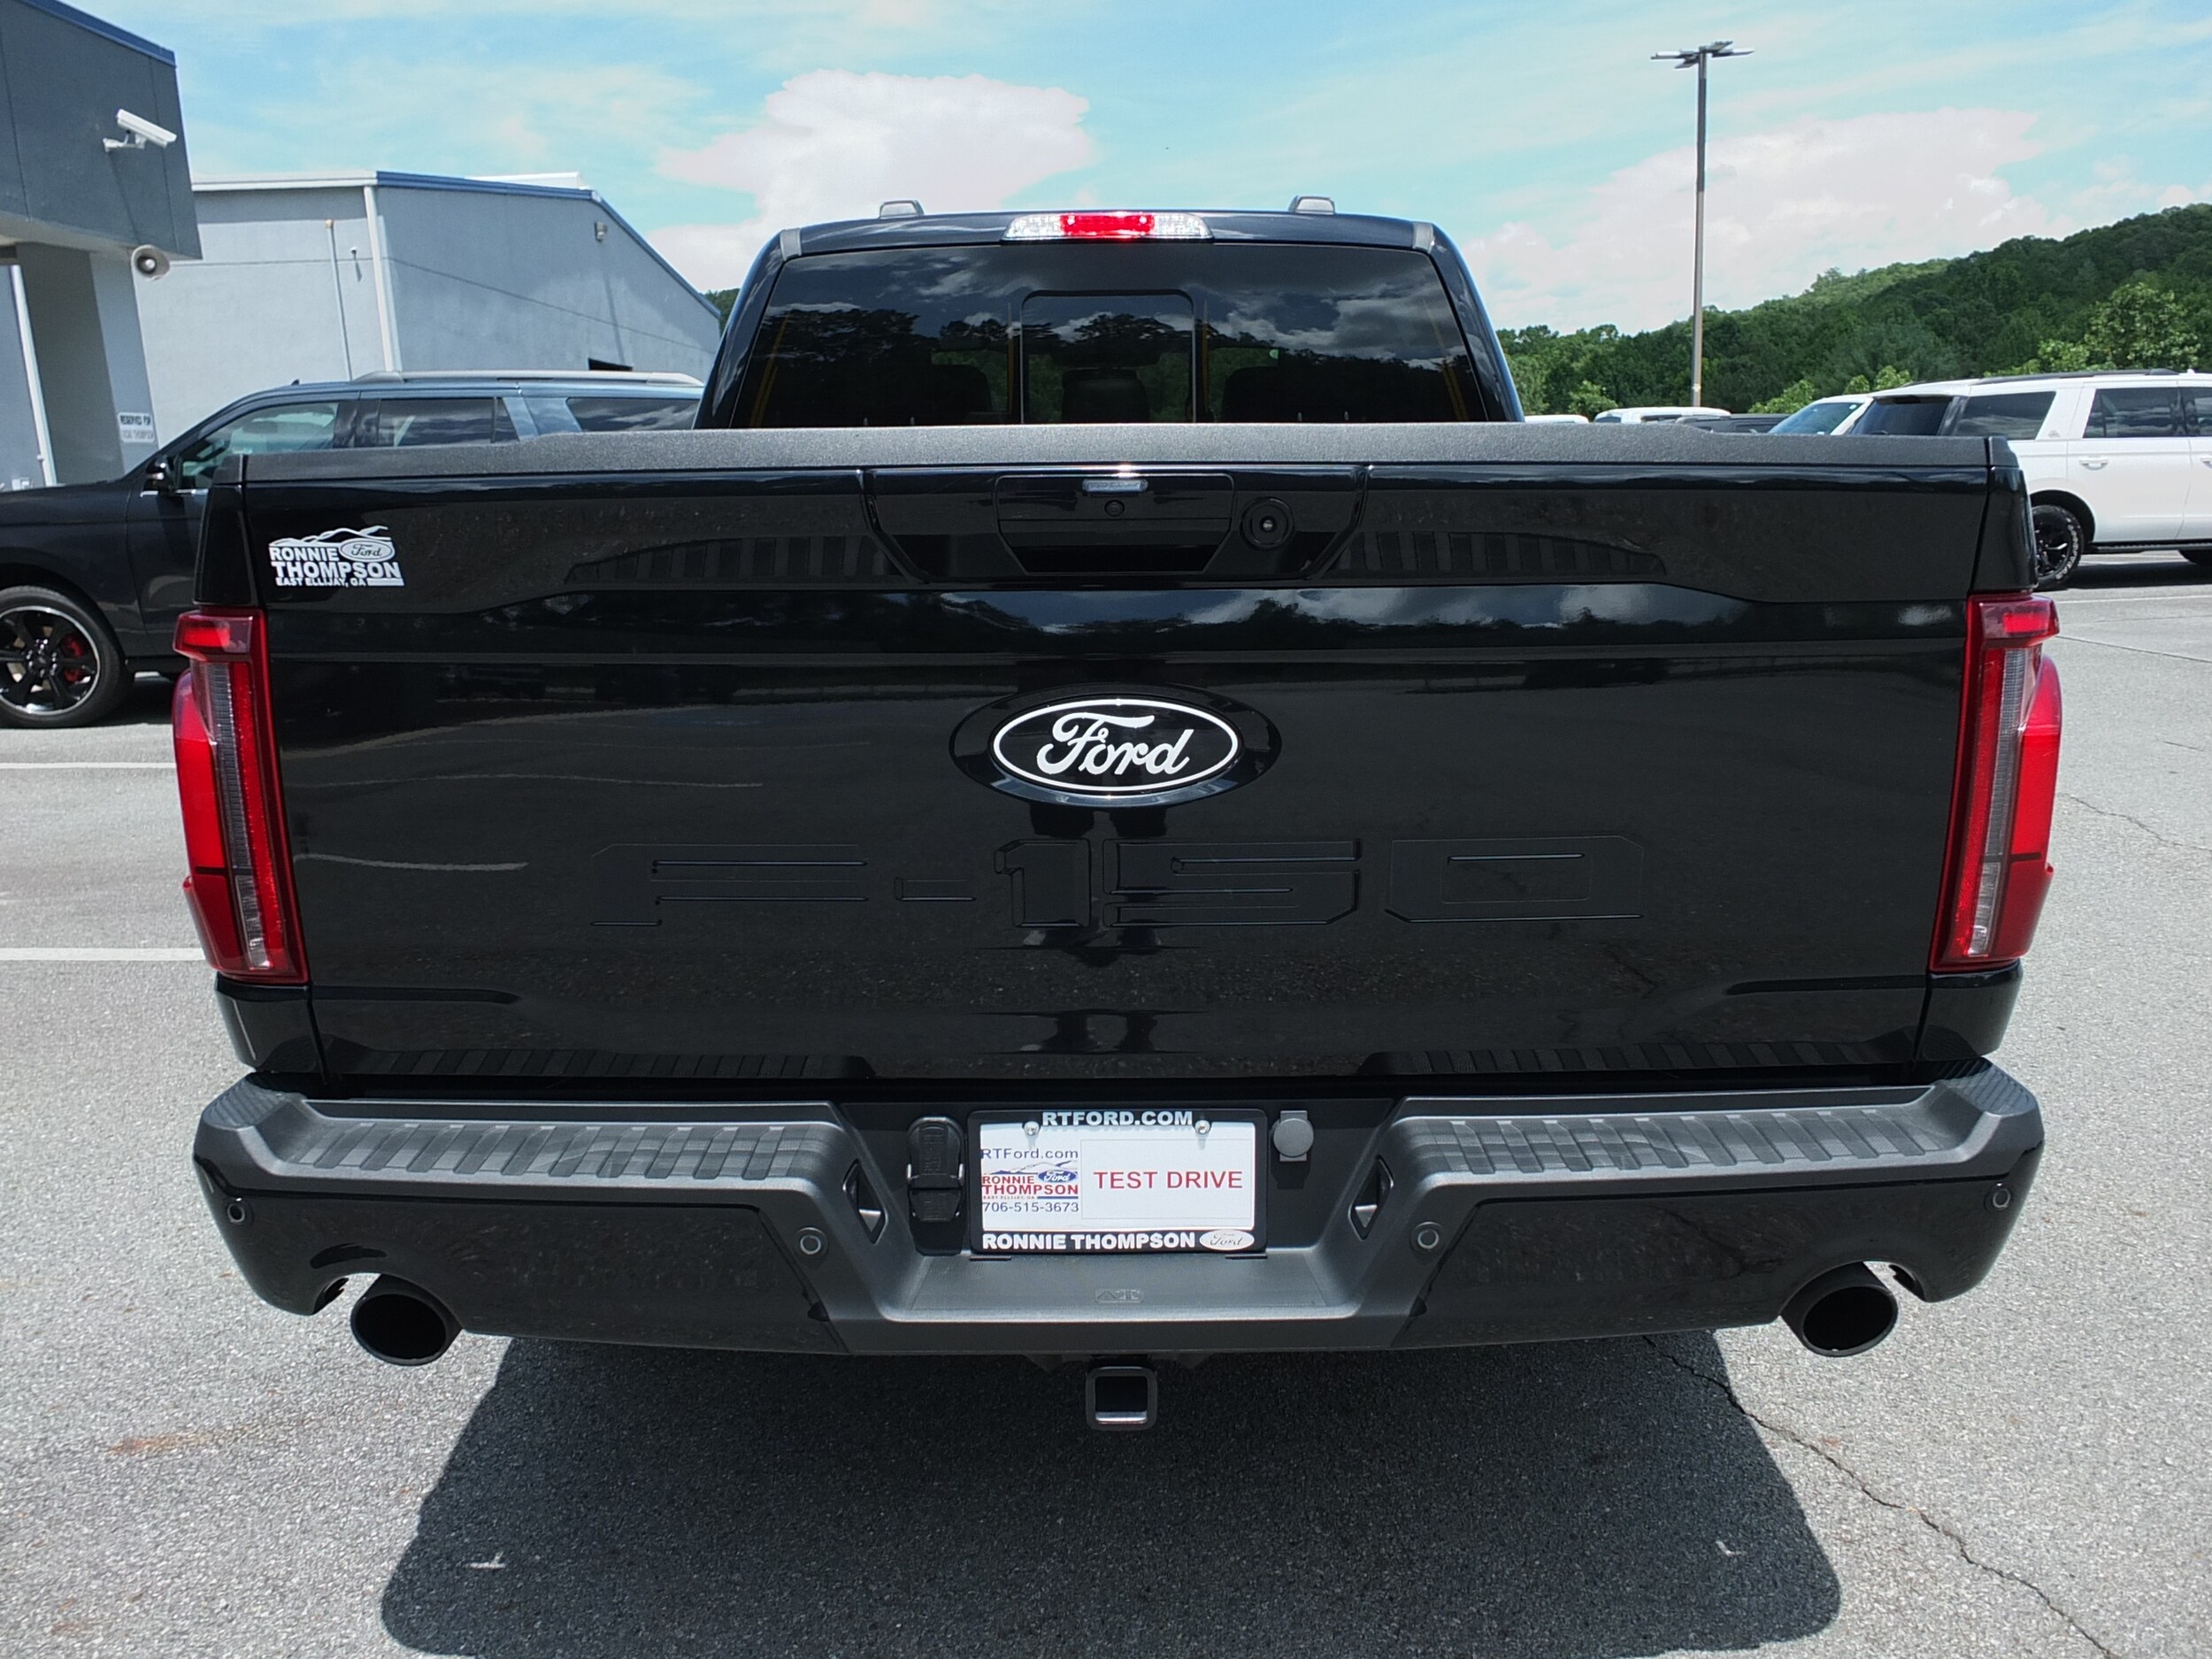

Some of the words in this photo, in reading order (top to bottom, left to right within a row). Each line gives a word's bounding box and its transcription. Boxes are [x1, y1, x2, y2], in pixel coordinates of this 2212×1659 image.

[269, 547, 339, 561] RONNIE
[351, 543, 381, 556] Ford
[271, 562, 401, 578] THOMPSON
[1037, 712, 1194, 774] Ford
[1042, 1111, 1192, 1125] RTFORD.COM
[981, 1148, 1079, 1159] RTFord.com
[1044, 1171, 1071, 1181] Ford
[1094, 1171, 1157, 1189] TEST
[1166, 1171, 1243, 1189] DRIVE
[982, 1185, 1079, 1194] THOMPSON
[983, 1202, 1079, 1212] 706-515-3673
[983, 1233, 1066, 1249] RONNIE
[1071, 1233, 1194, 1248] THOMPSON
[1210, 1233, 1243, 1246] Ford
